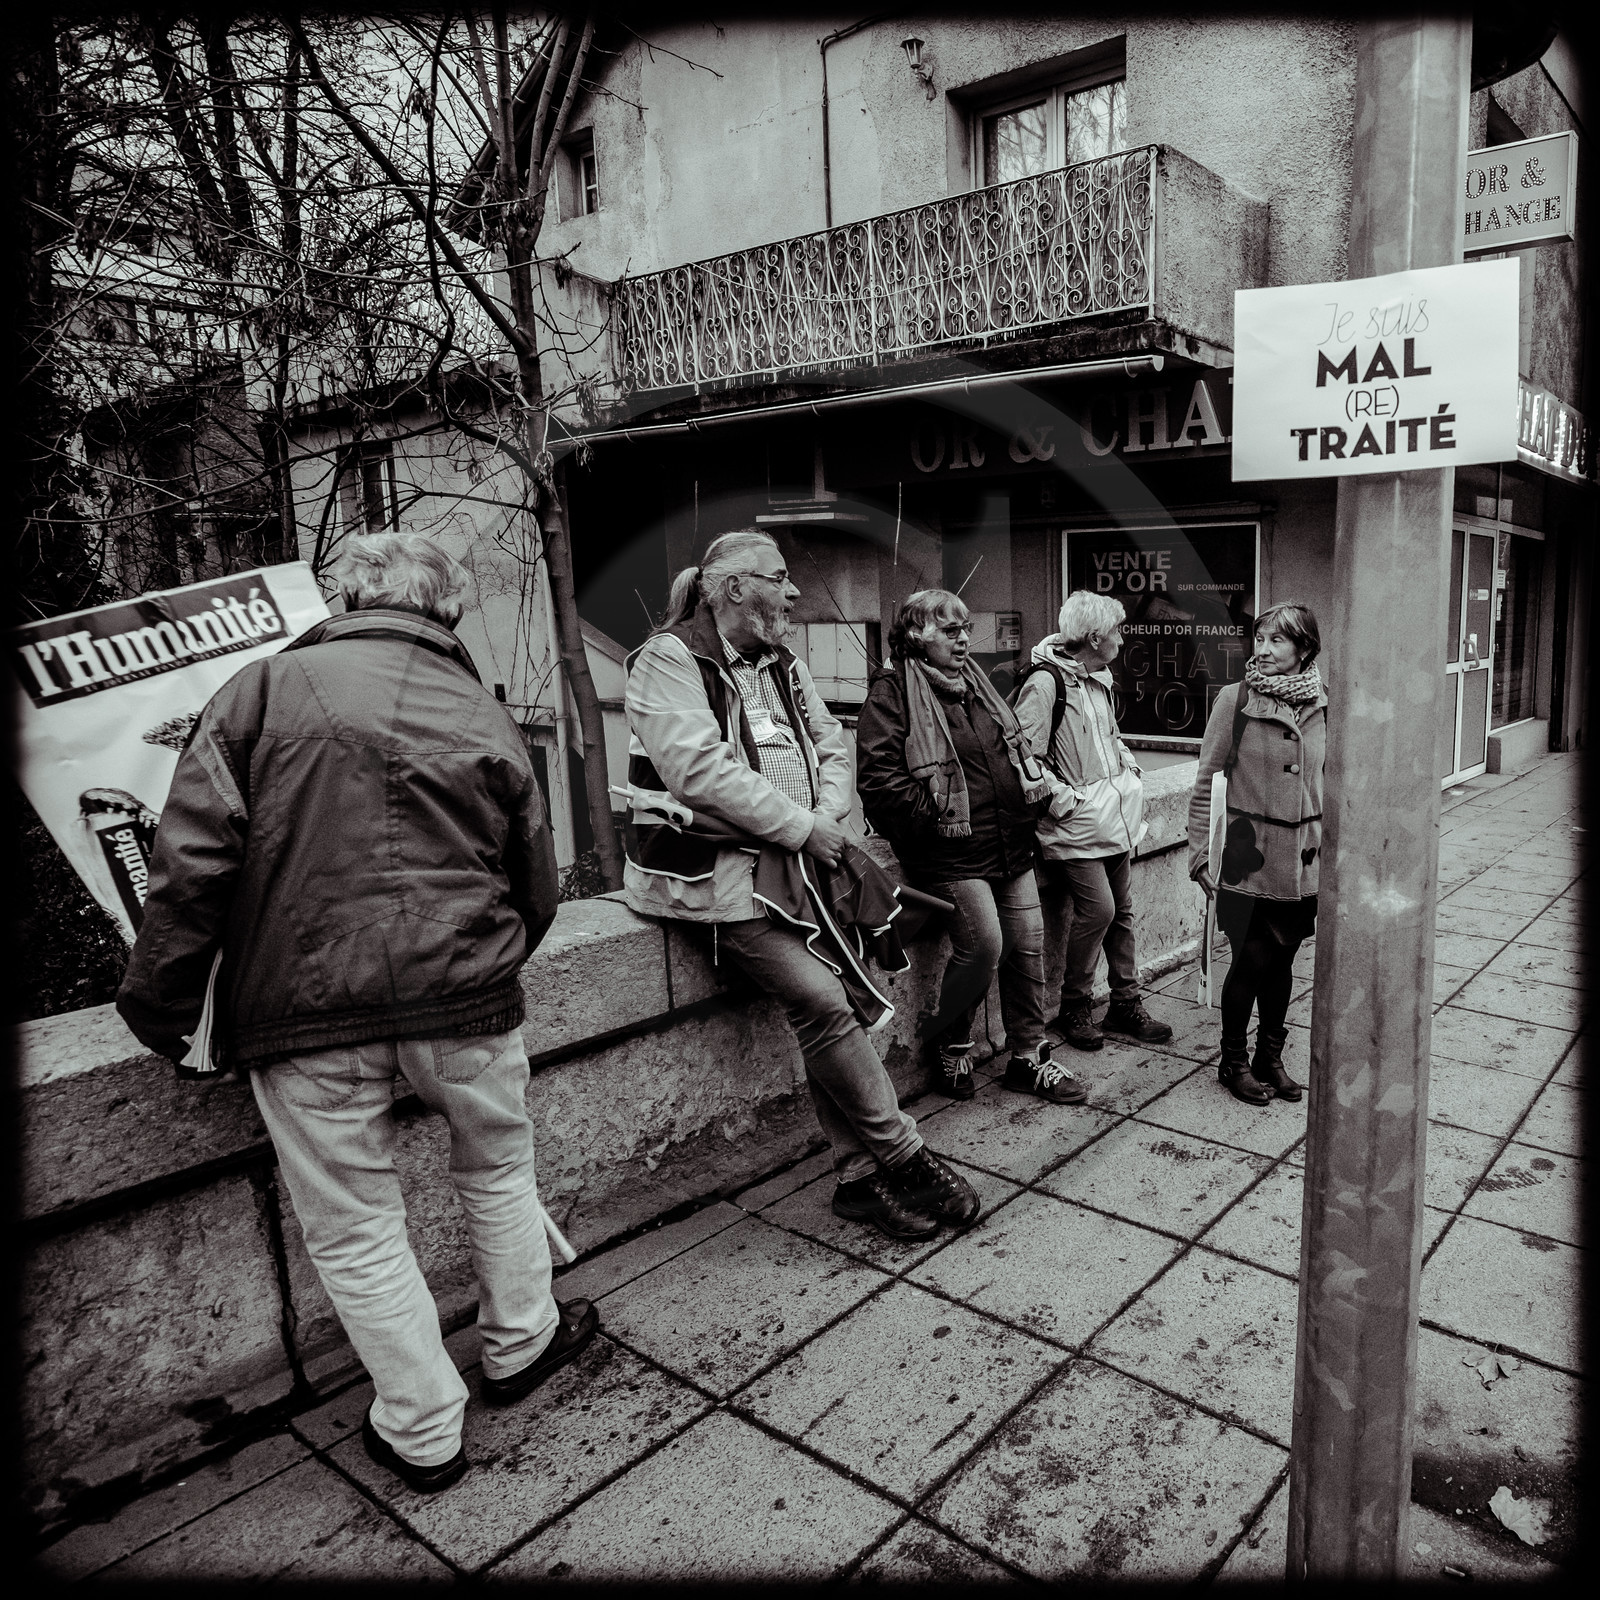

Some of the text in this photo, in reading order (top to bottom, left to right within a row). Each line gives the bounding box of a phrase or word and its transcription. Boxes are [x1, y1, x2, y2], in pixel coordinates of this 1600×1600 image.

[1464, 157, 1546, 199] OR &
[1464, 195, 1560, 235] HANGE
[1317, 295, 1431, 346] Je suis
[1315, 338, 1432, 388] MAL
[1345, 385, 1400, 422] (RE)
[910, 379, 1233, 473] OR & CHA
[1290, 403, 1457, 462] TRAITÉ
[1092, 550, 1172, 571] VENTE
[1096, 570, 1168, 593] D'OR
[1177, 583, 1245, 591] SUR COMMANDE
[18, 587, 282, 697] l'Humanité
[1164, 624, 1192, 636] D'OR
[1195, 625, 1245, 636] FRANCE
[1114, 640, 1244, 680] CHAT
